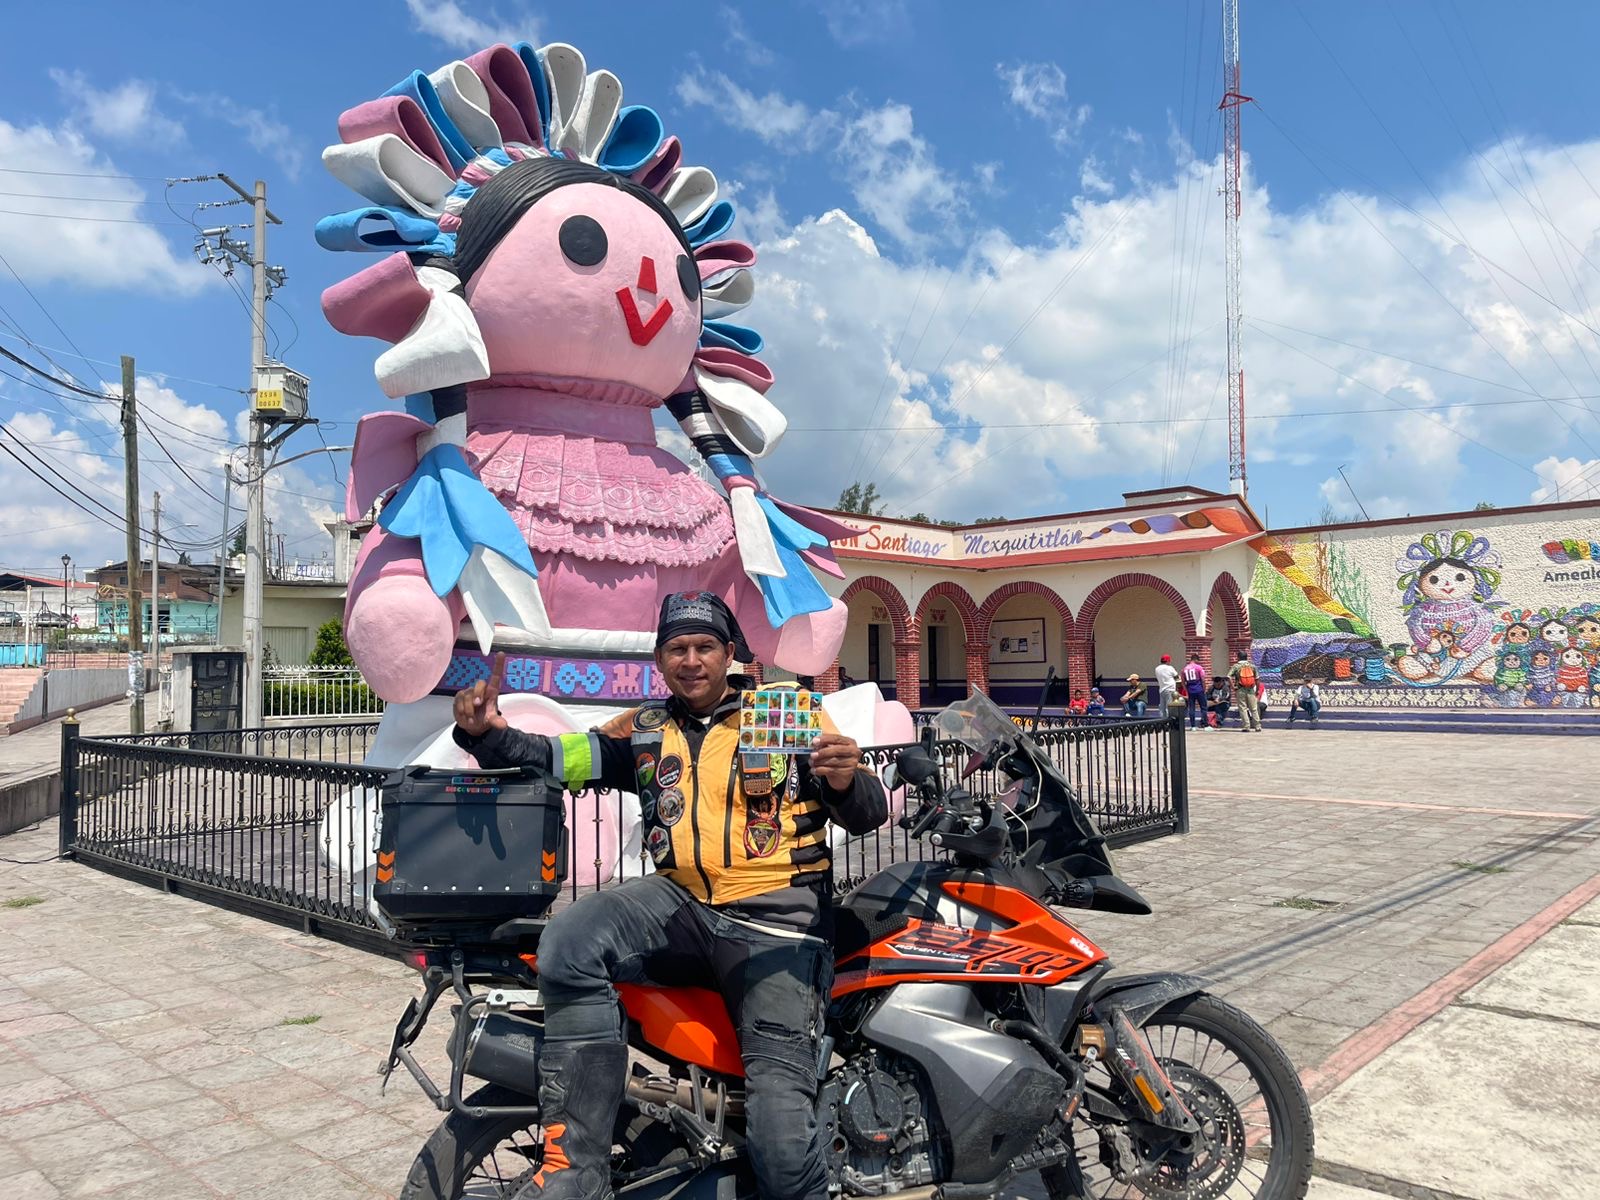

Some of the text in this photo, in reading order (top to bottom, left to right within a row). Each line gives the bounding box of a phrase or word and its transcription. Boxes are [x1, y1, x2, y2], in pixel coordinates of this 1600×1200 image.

[865, 524, 947, 557] Santiago
[963, 527, 1084, 556] Mexquititlán
[1184, 669, 1197, 681] 10
[1068, 936, 1095, 959] KTM
